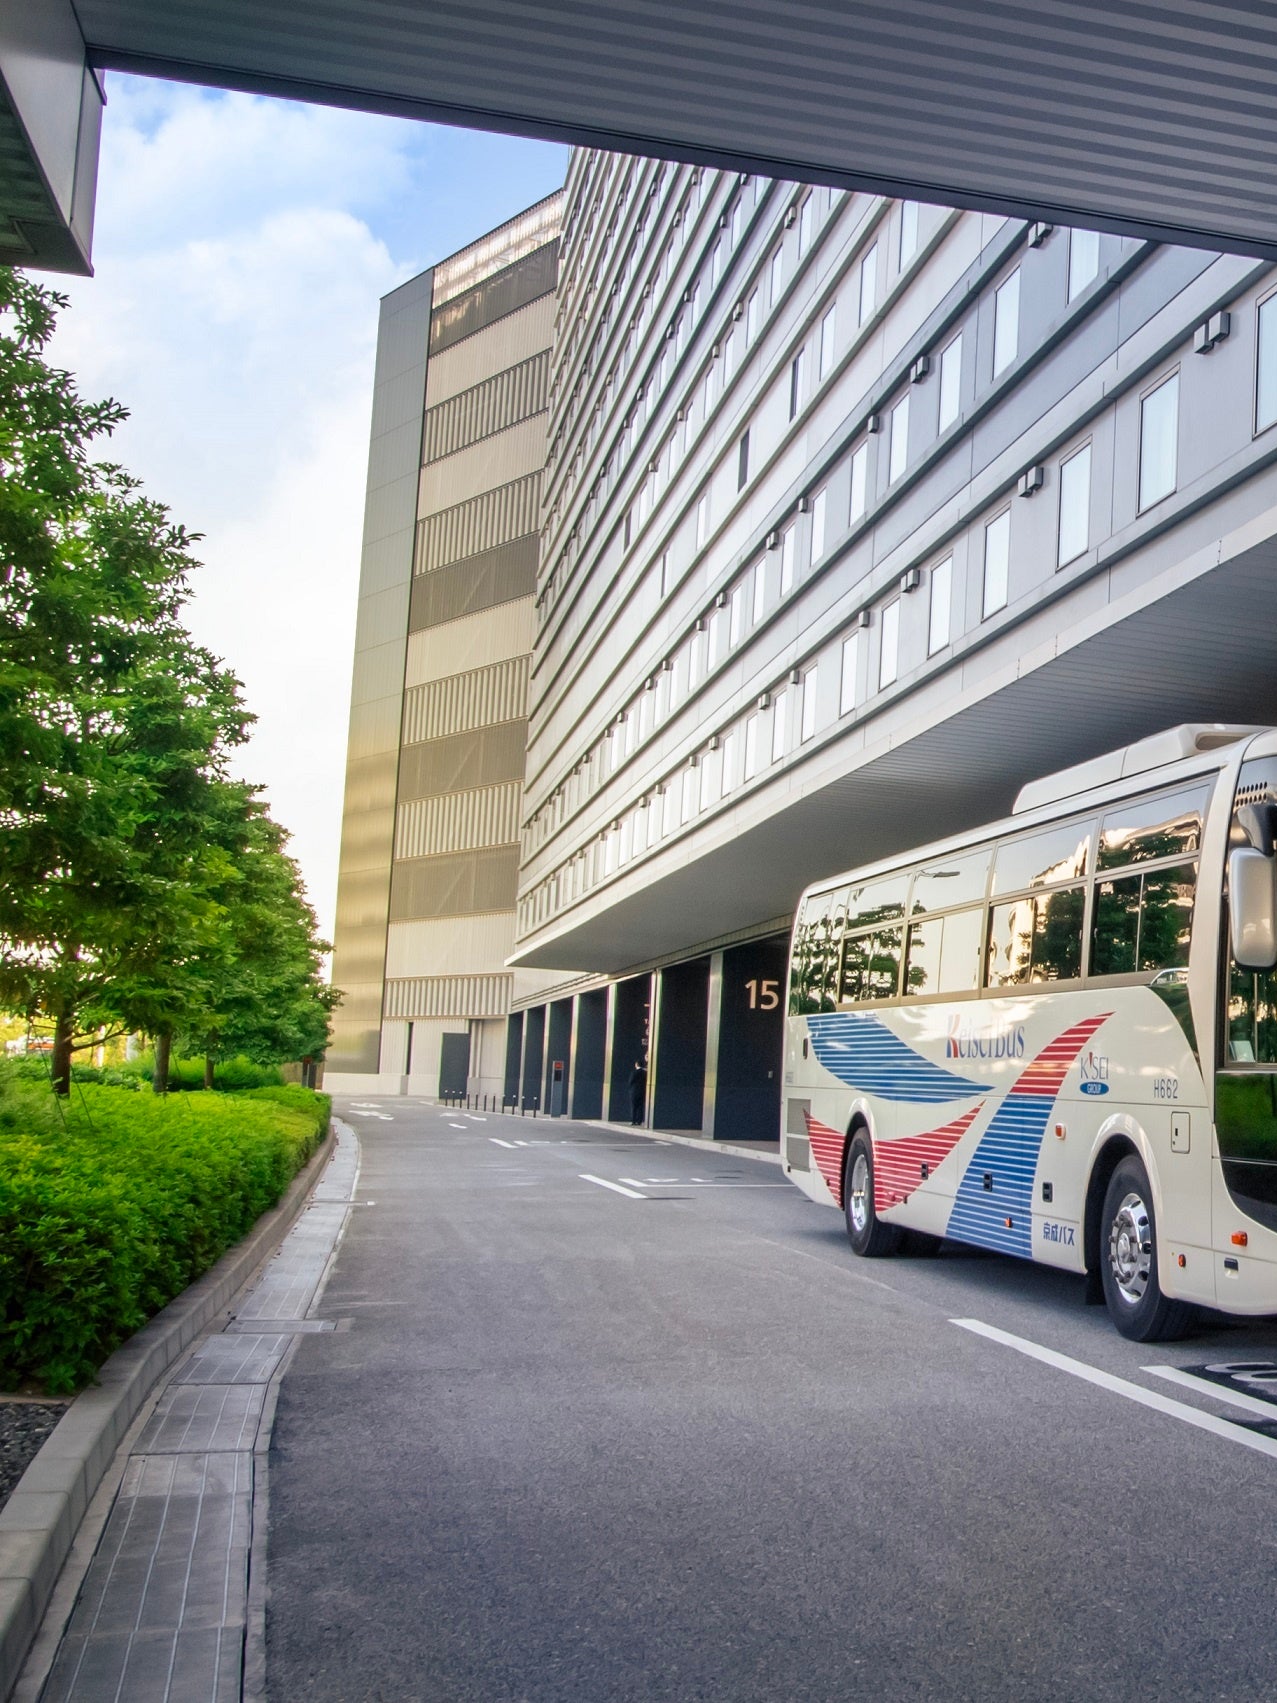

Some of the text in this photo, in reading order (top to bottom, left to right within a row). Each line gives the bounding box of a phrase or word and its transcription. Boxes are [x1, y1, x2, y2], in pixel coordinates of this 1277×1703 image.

[745, 979, 779, 1010] 15
[1153, 1079, 1178, 1099] H662
[1043, 1221, 1075, 1247] 京成バス
